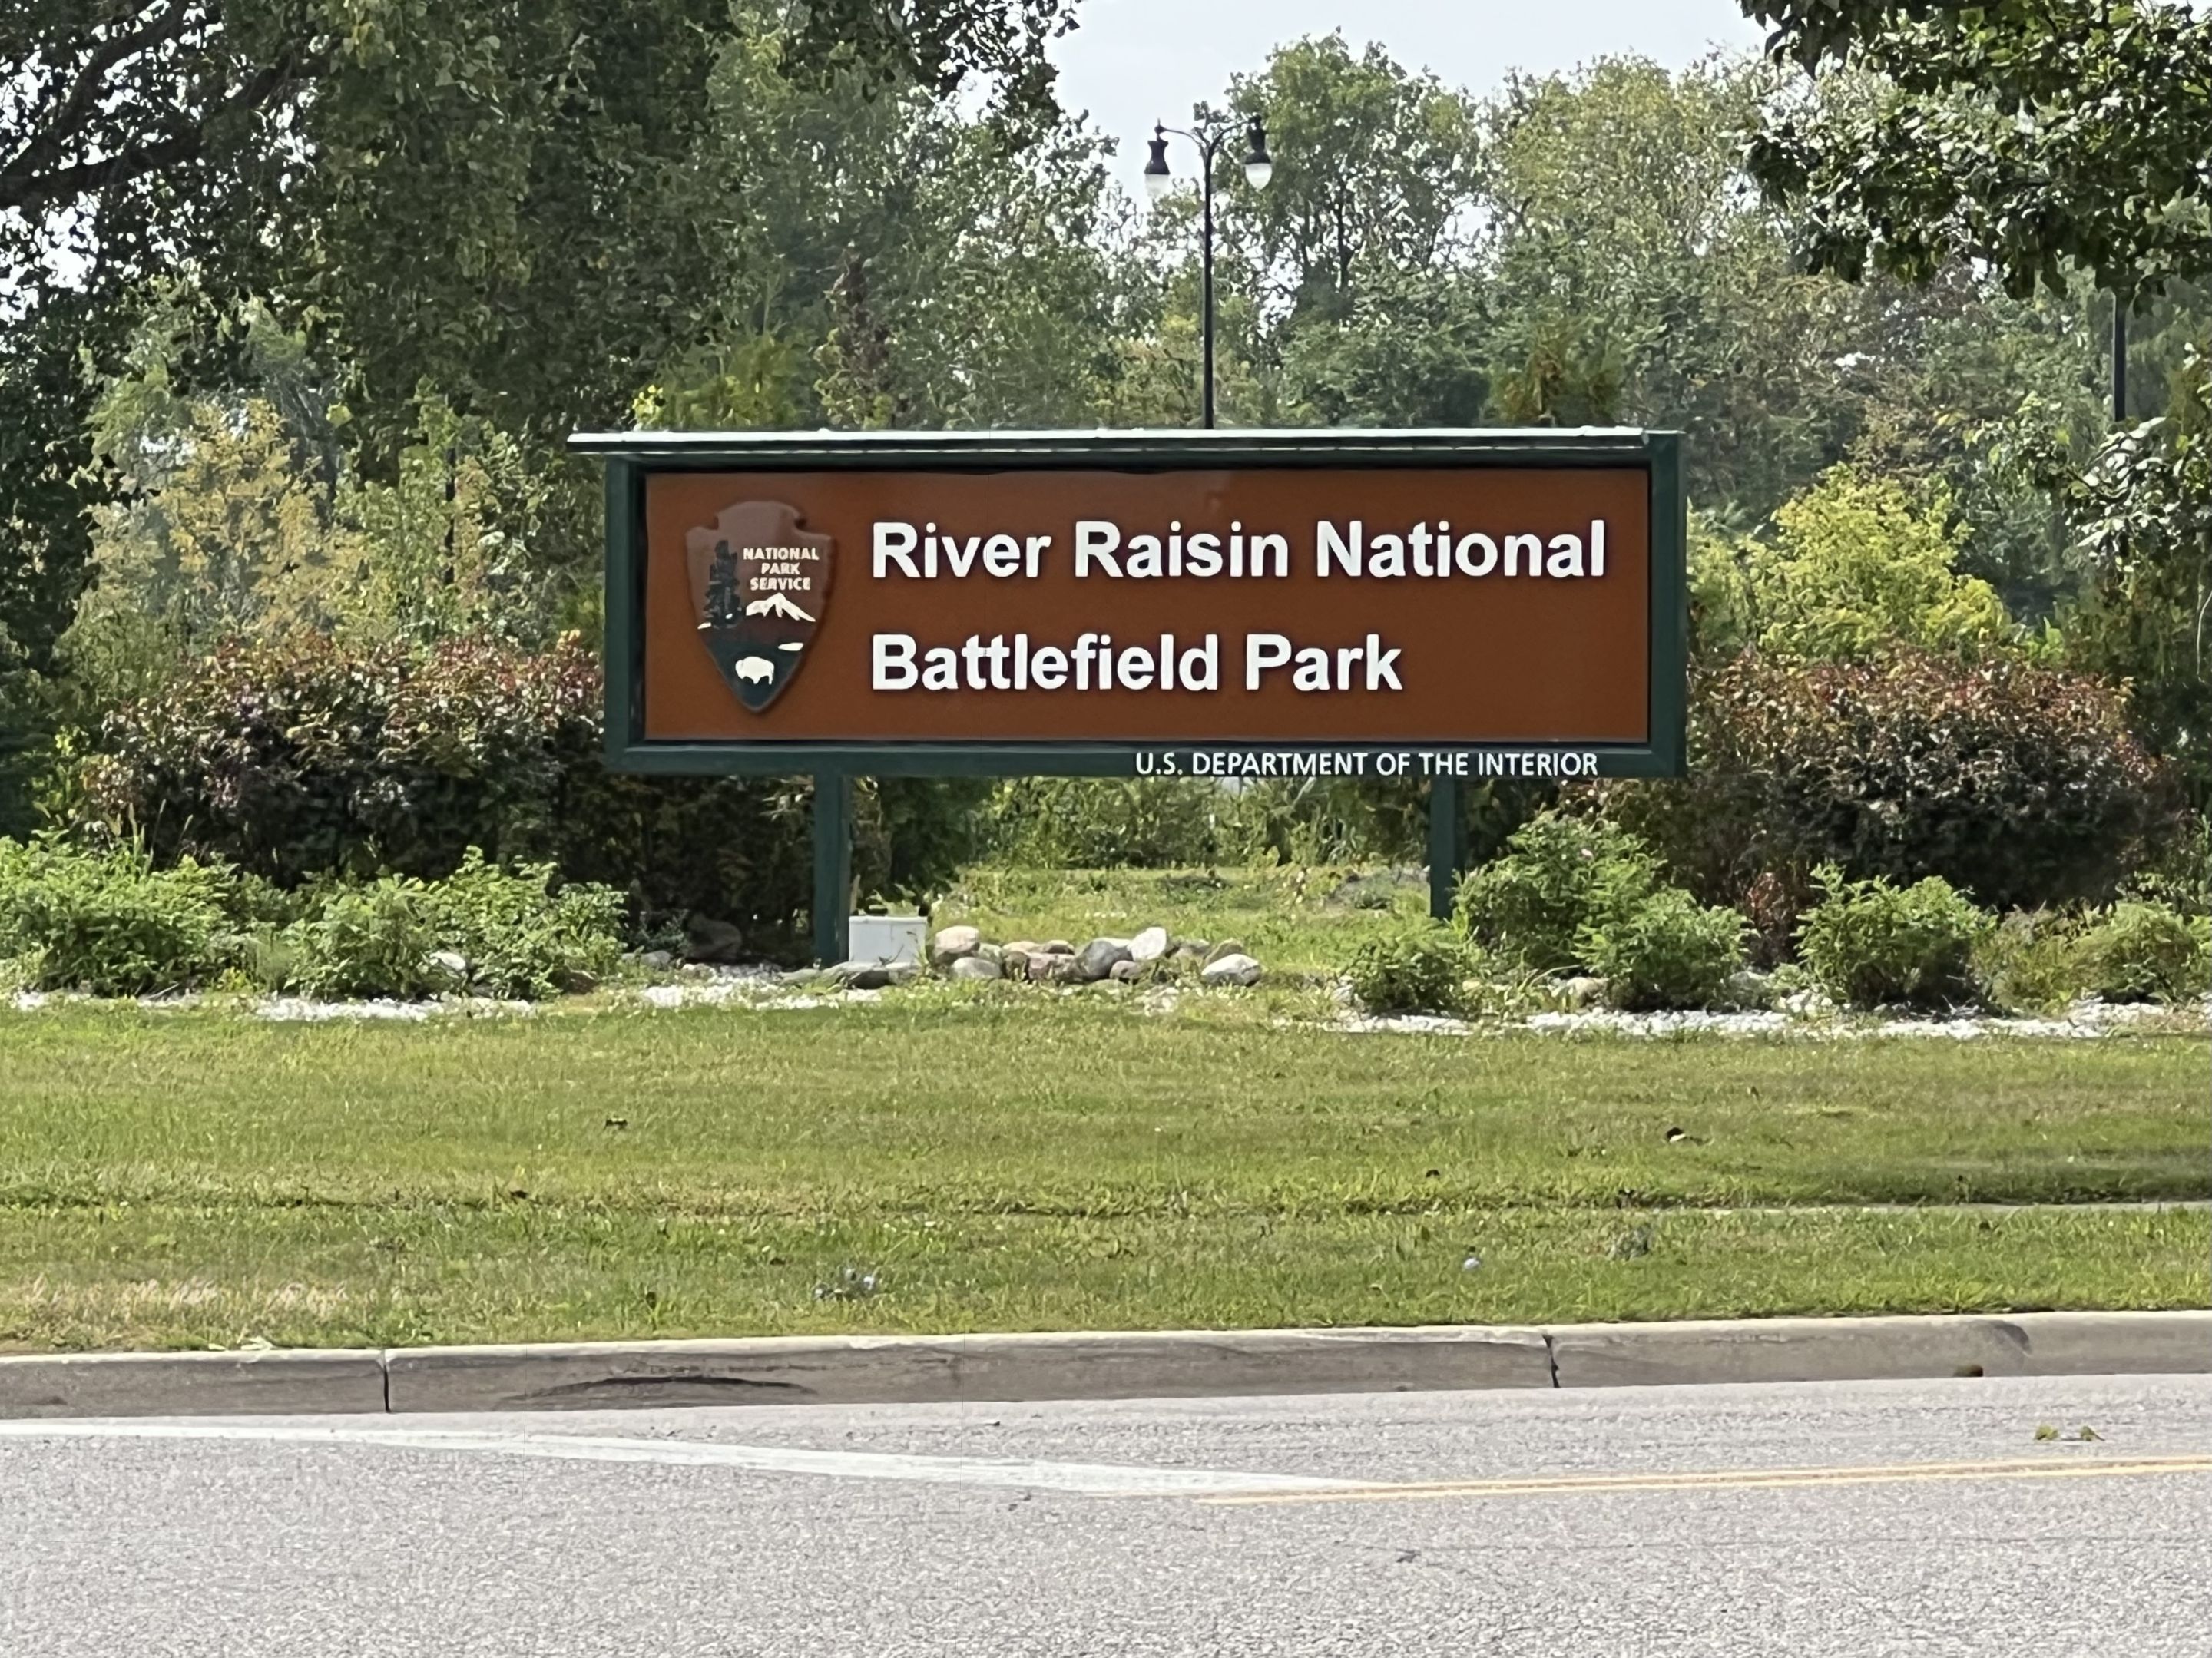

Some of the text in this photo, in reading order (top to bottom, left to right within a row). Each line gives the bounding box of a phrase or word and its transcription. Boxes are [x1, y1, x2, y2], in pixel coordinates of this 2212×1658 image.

[743, 547, 820, 561] NATIONAL
[873, 519, 1605, 579] River Raisin National
[760, 562, 800, 575] PARK
[750, 577, 811, 591] SERVICE
[873, 633, 1404, 692] Battlefield Park
[1135, 751, 1599, 776] U.S. DEPARTMENT OF THE INTERIOR
